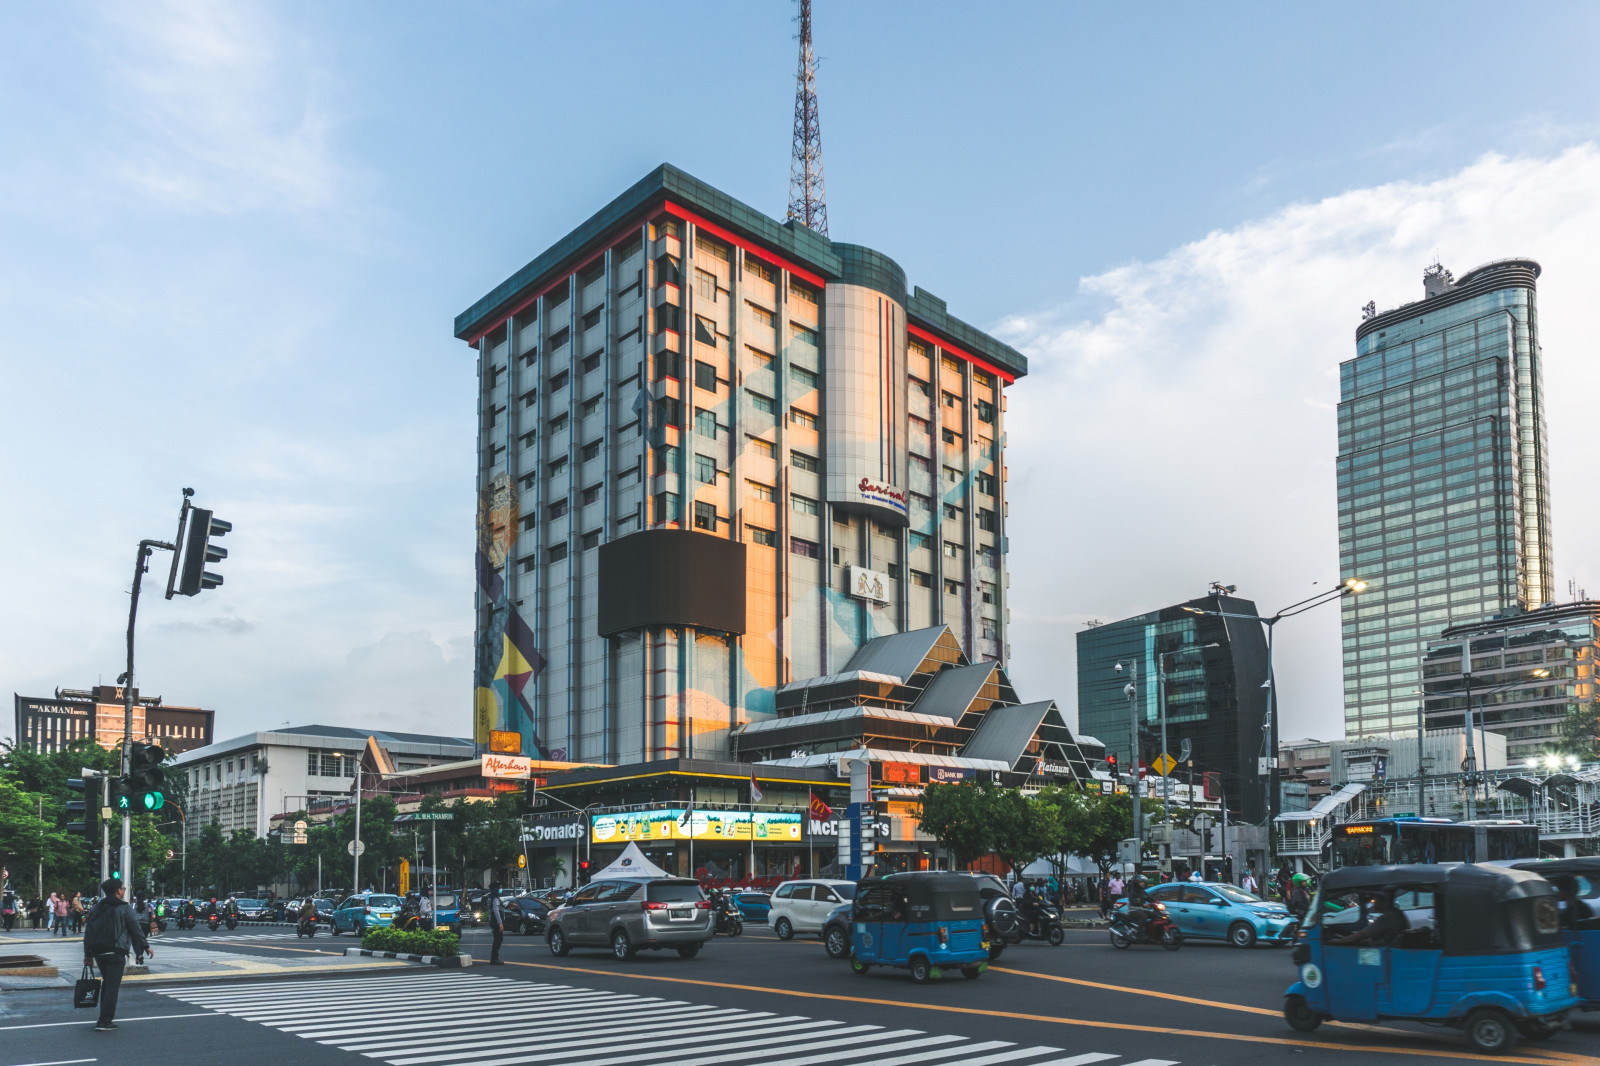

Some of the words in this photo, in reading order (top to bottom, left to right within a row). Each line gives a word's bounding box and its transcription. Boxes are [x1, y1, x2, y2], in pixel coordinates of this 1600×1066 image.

[38, 705, 74, 714] AKMANI
[486, 757, 528, 773] Afterhour
[1038, 761, 1069, 774] Platinum
